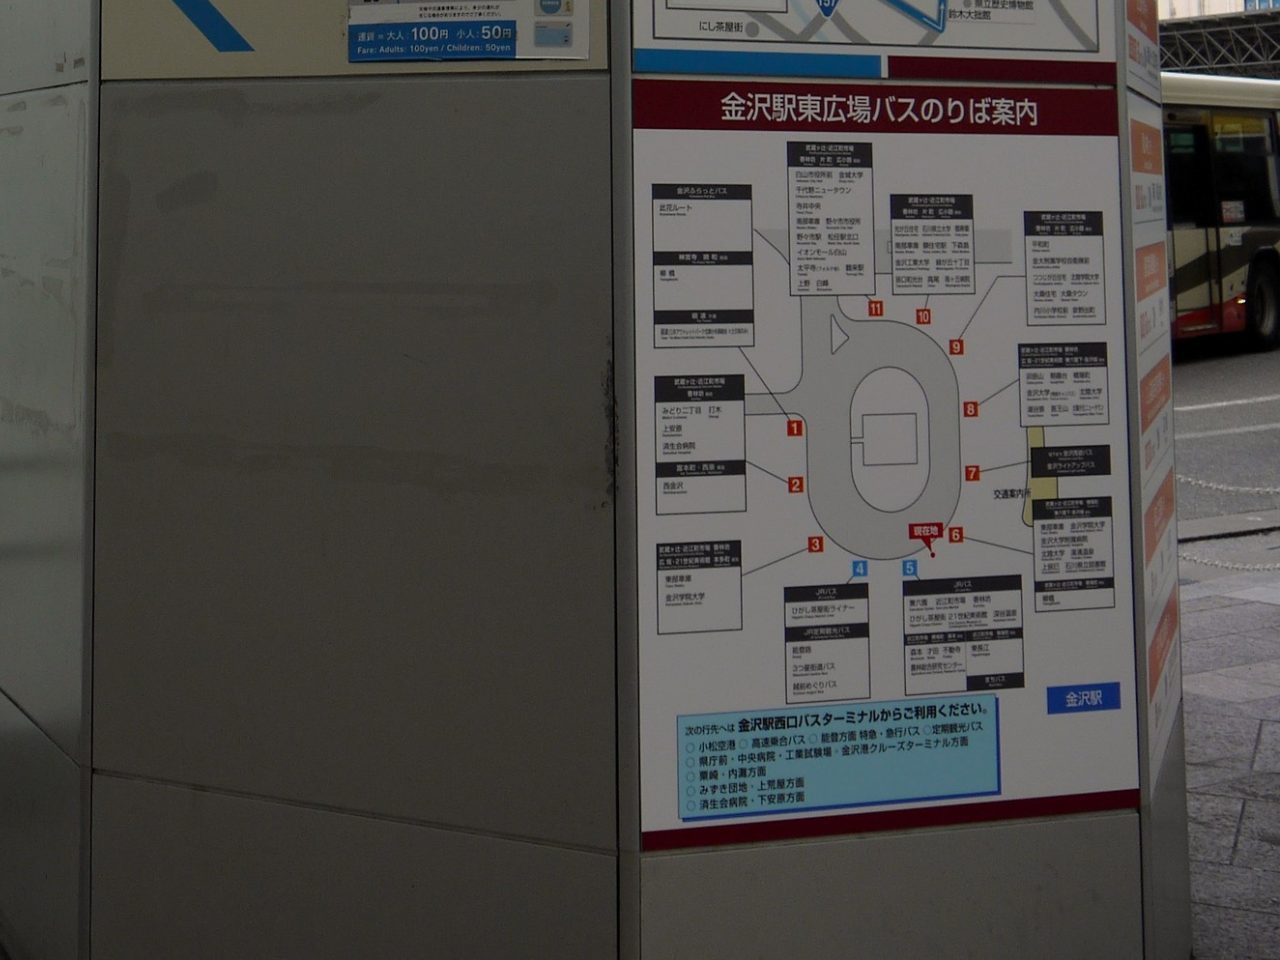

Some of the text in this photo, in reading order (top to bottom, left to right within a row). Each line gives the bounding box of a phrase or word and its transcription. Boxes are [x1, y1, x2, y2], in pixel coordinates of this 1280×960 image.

[698, 21, 744, 33] にし茶屋街
[410, 44, 439, 53] 100yen
[485, 43, 511, 52] 50yen
[720, 91, 1039, 127] 金沢駅東広場バスのりば案内
[1066, 690, 1103, 708] 金沢駅
[685, 724, 736, 737] 次の行先へは
[698, 739, 736, 753] 小松空港
